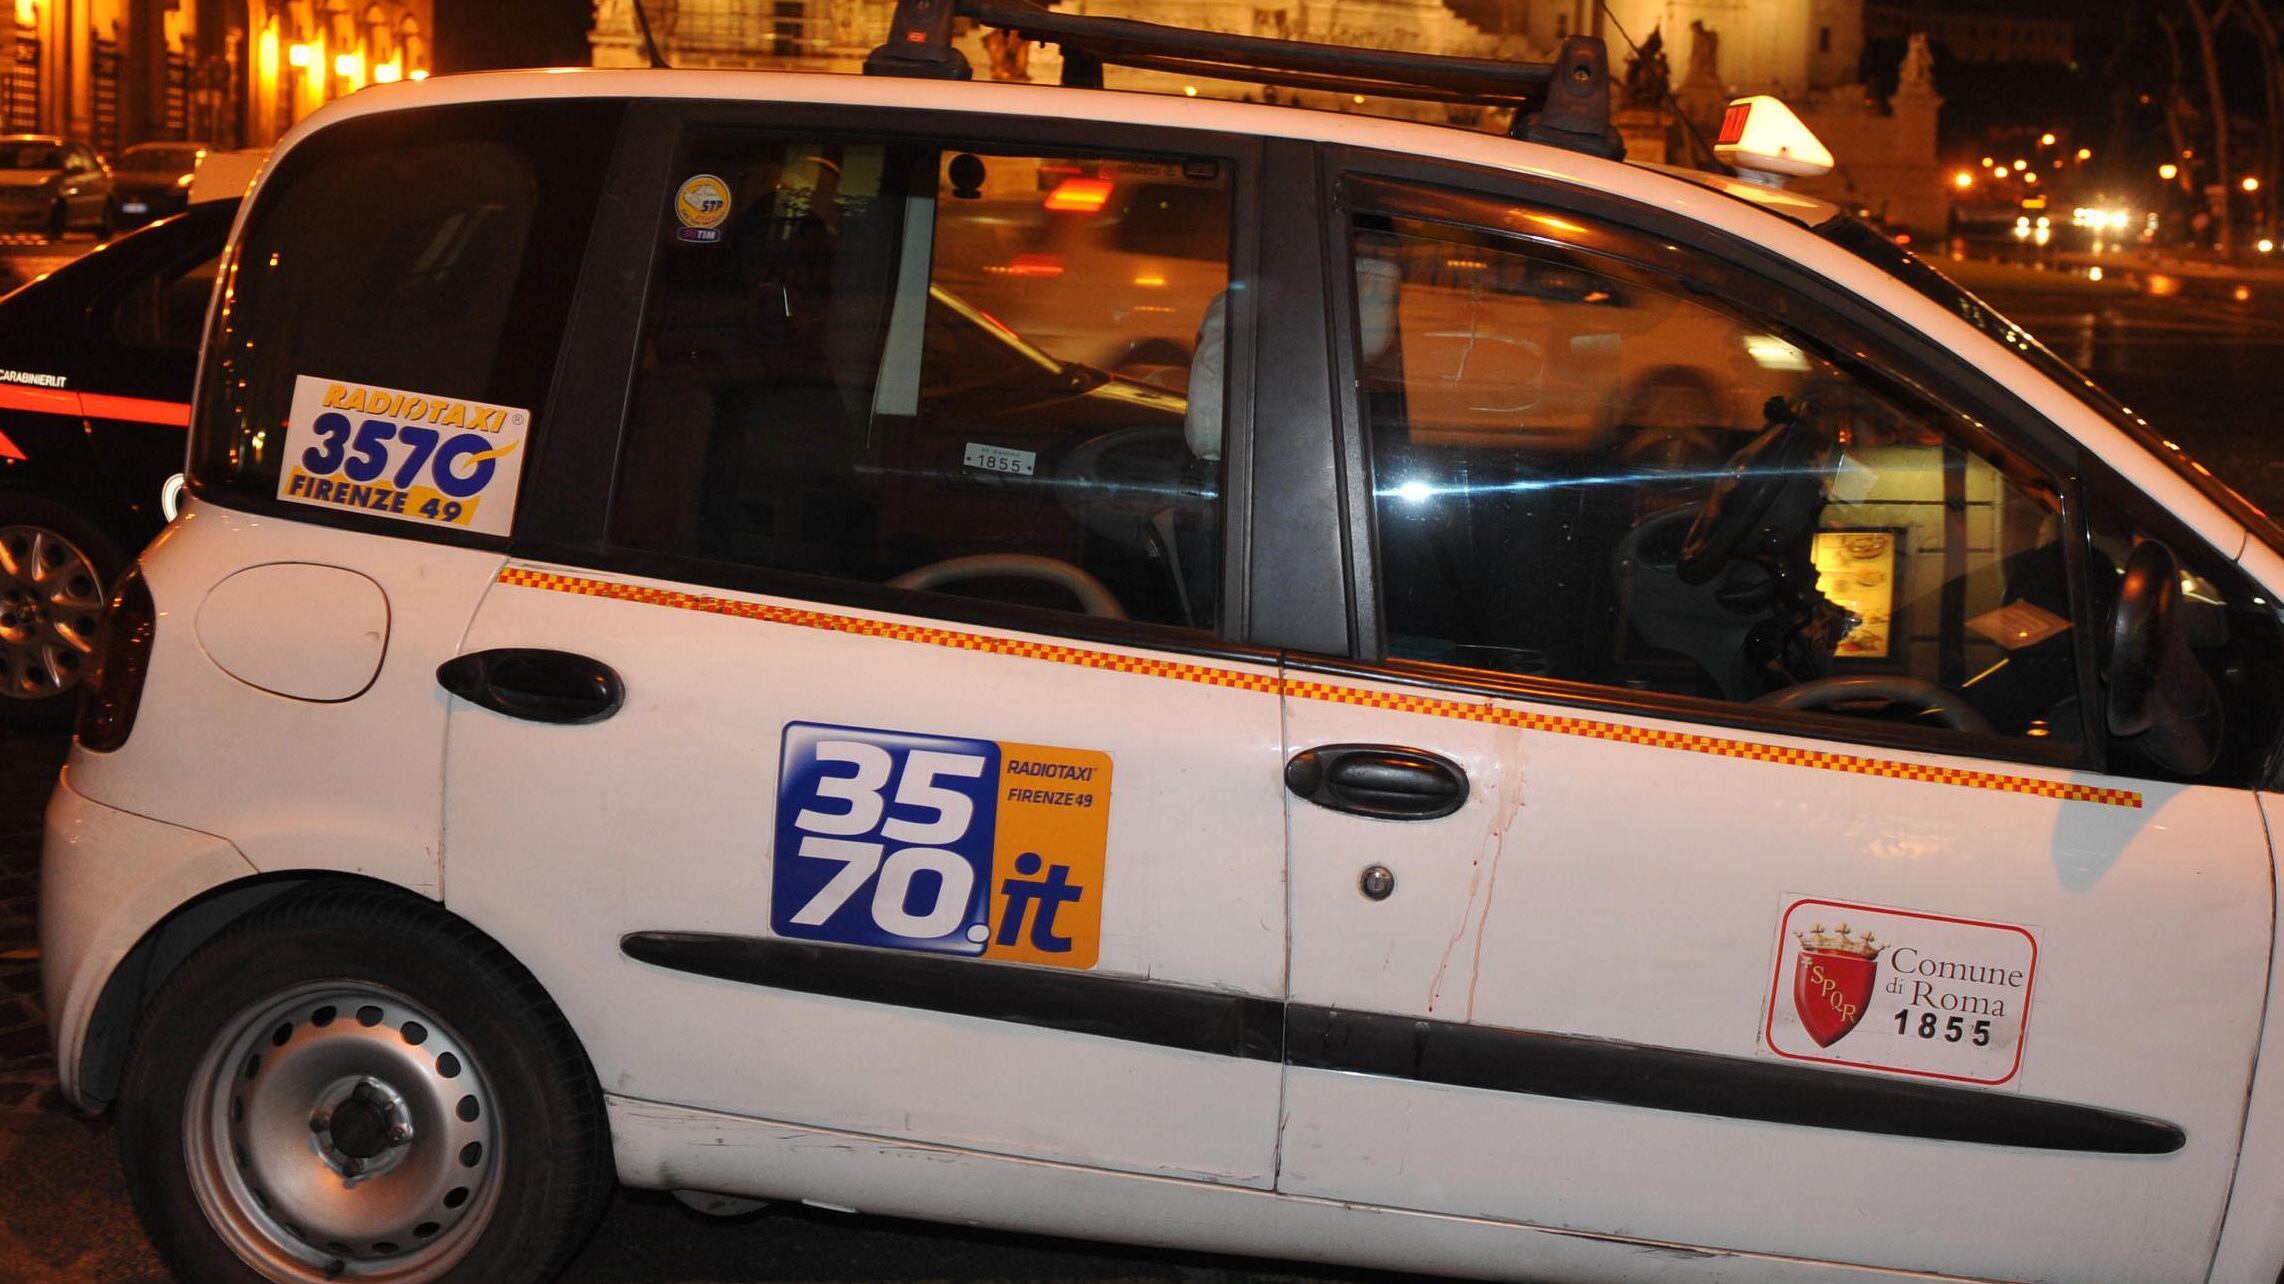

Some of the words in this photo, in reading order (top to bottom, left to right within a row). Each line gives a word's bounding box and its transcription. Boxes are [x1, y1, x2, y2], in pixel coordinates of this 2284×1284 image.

[701, 200, 724, 212] STP
[697, 230, 717, 240] TIM
[321, 384, 507, 434] RADIOTAXI
[302, 412, 497, 498] 3570
[978, 454, 1021, 473] 1855
[289, 474, 410, 513] FIRENZE
[419, 498, 462, 523] 49
[1006, 760, 1093, 782] RADIOTAXI
[794, 740, 987, 846] 35
[1007, 788, 1075, 806] FIRENZE
[1074, 794, 1093, 808] 49
[1890, 946, 2024, 988] Comune
[1810, 965, 1858, 1024] SPQR
[1885, 976, 1905, 996] di
[1910, 980, 2006, 1017] Roma
[1894, 1008, 1992, 1047] 1855
